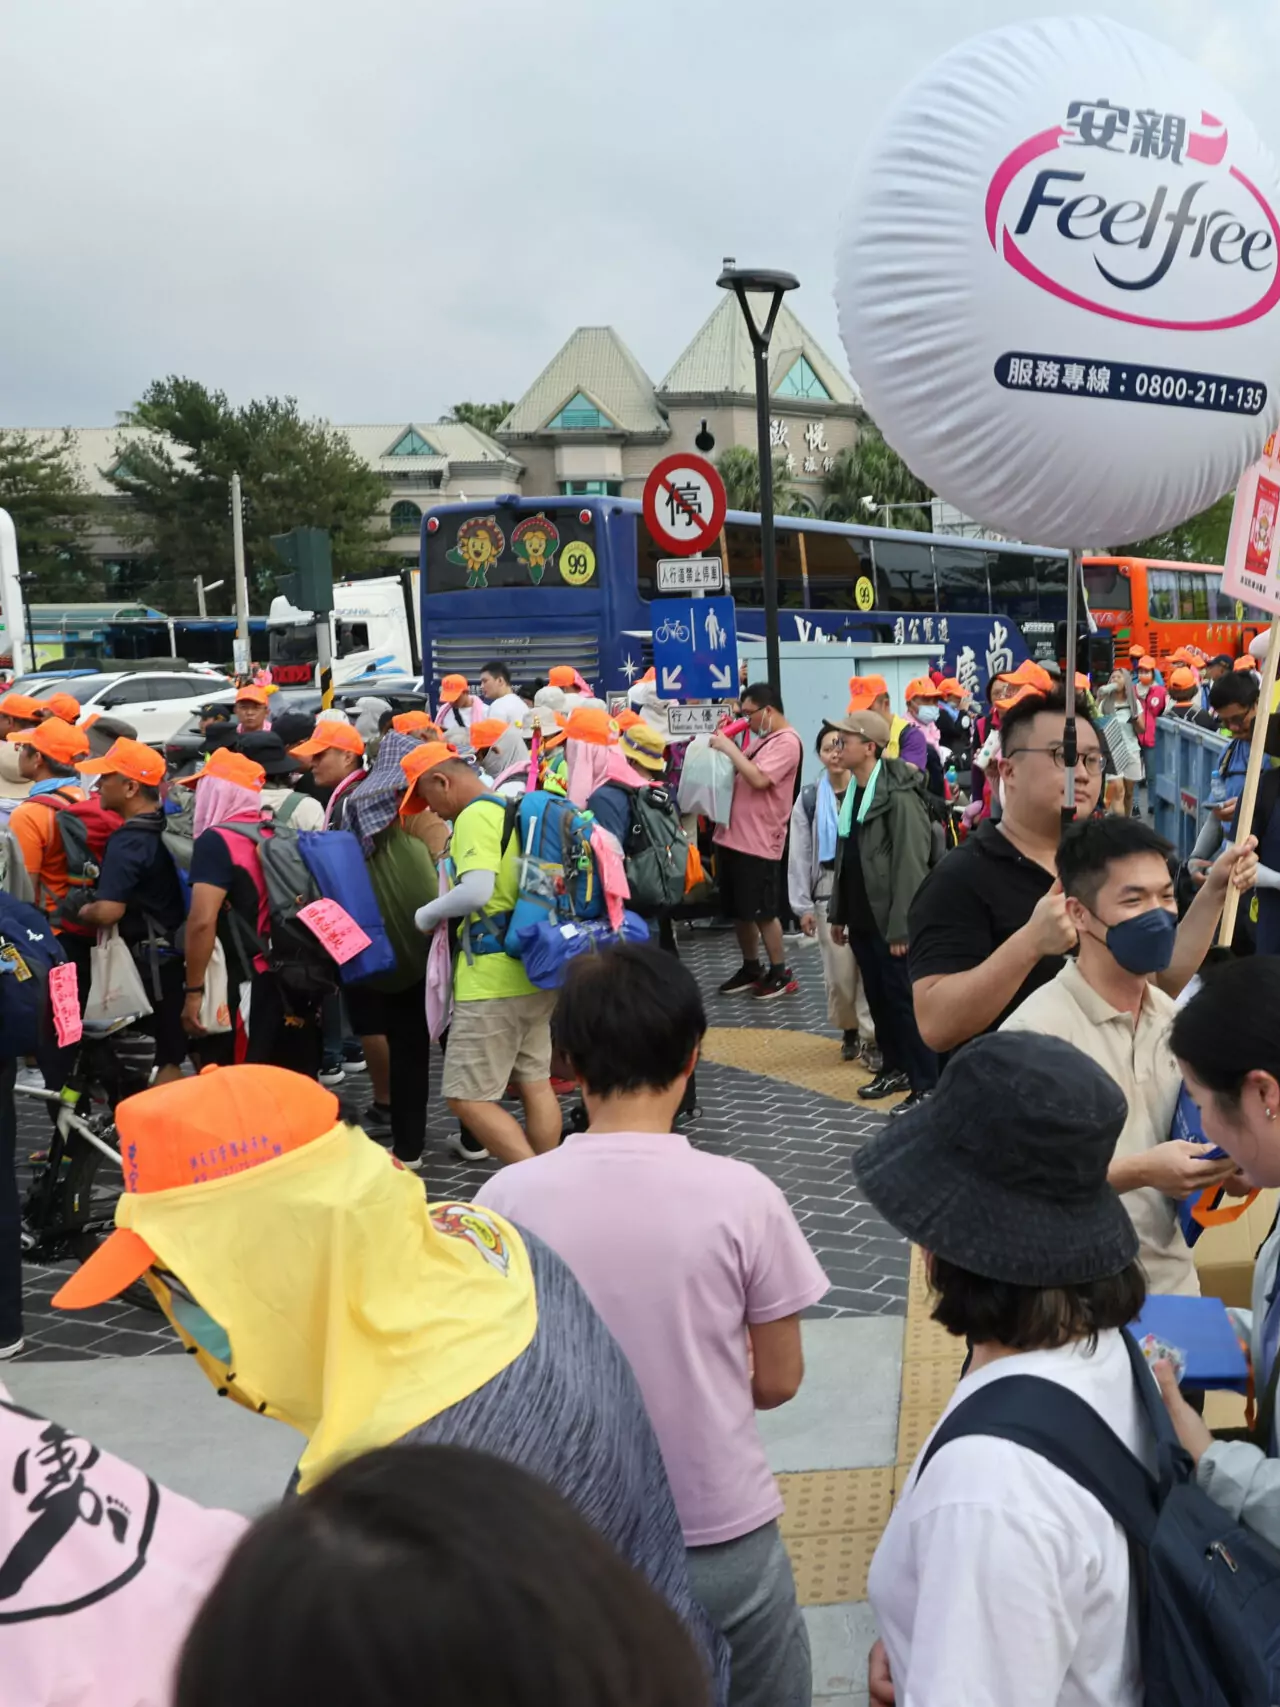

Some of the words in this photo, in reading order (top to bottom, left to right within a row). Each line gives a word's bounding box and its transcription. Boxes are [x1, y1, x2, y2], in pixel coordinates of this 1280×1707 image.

[1064, 97, 1188, 166] 安親
[1013, 168, 1273, 292] Feelfree
[665, 481, 702, 527] 停
[568, 554, 587, 575] 99
